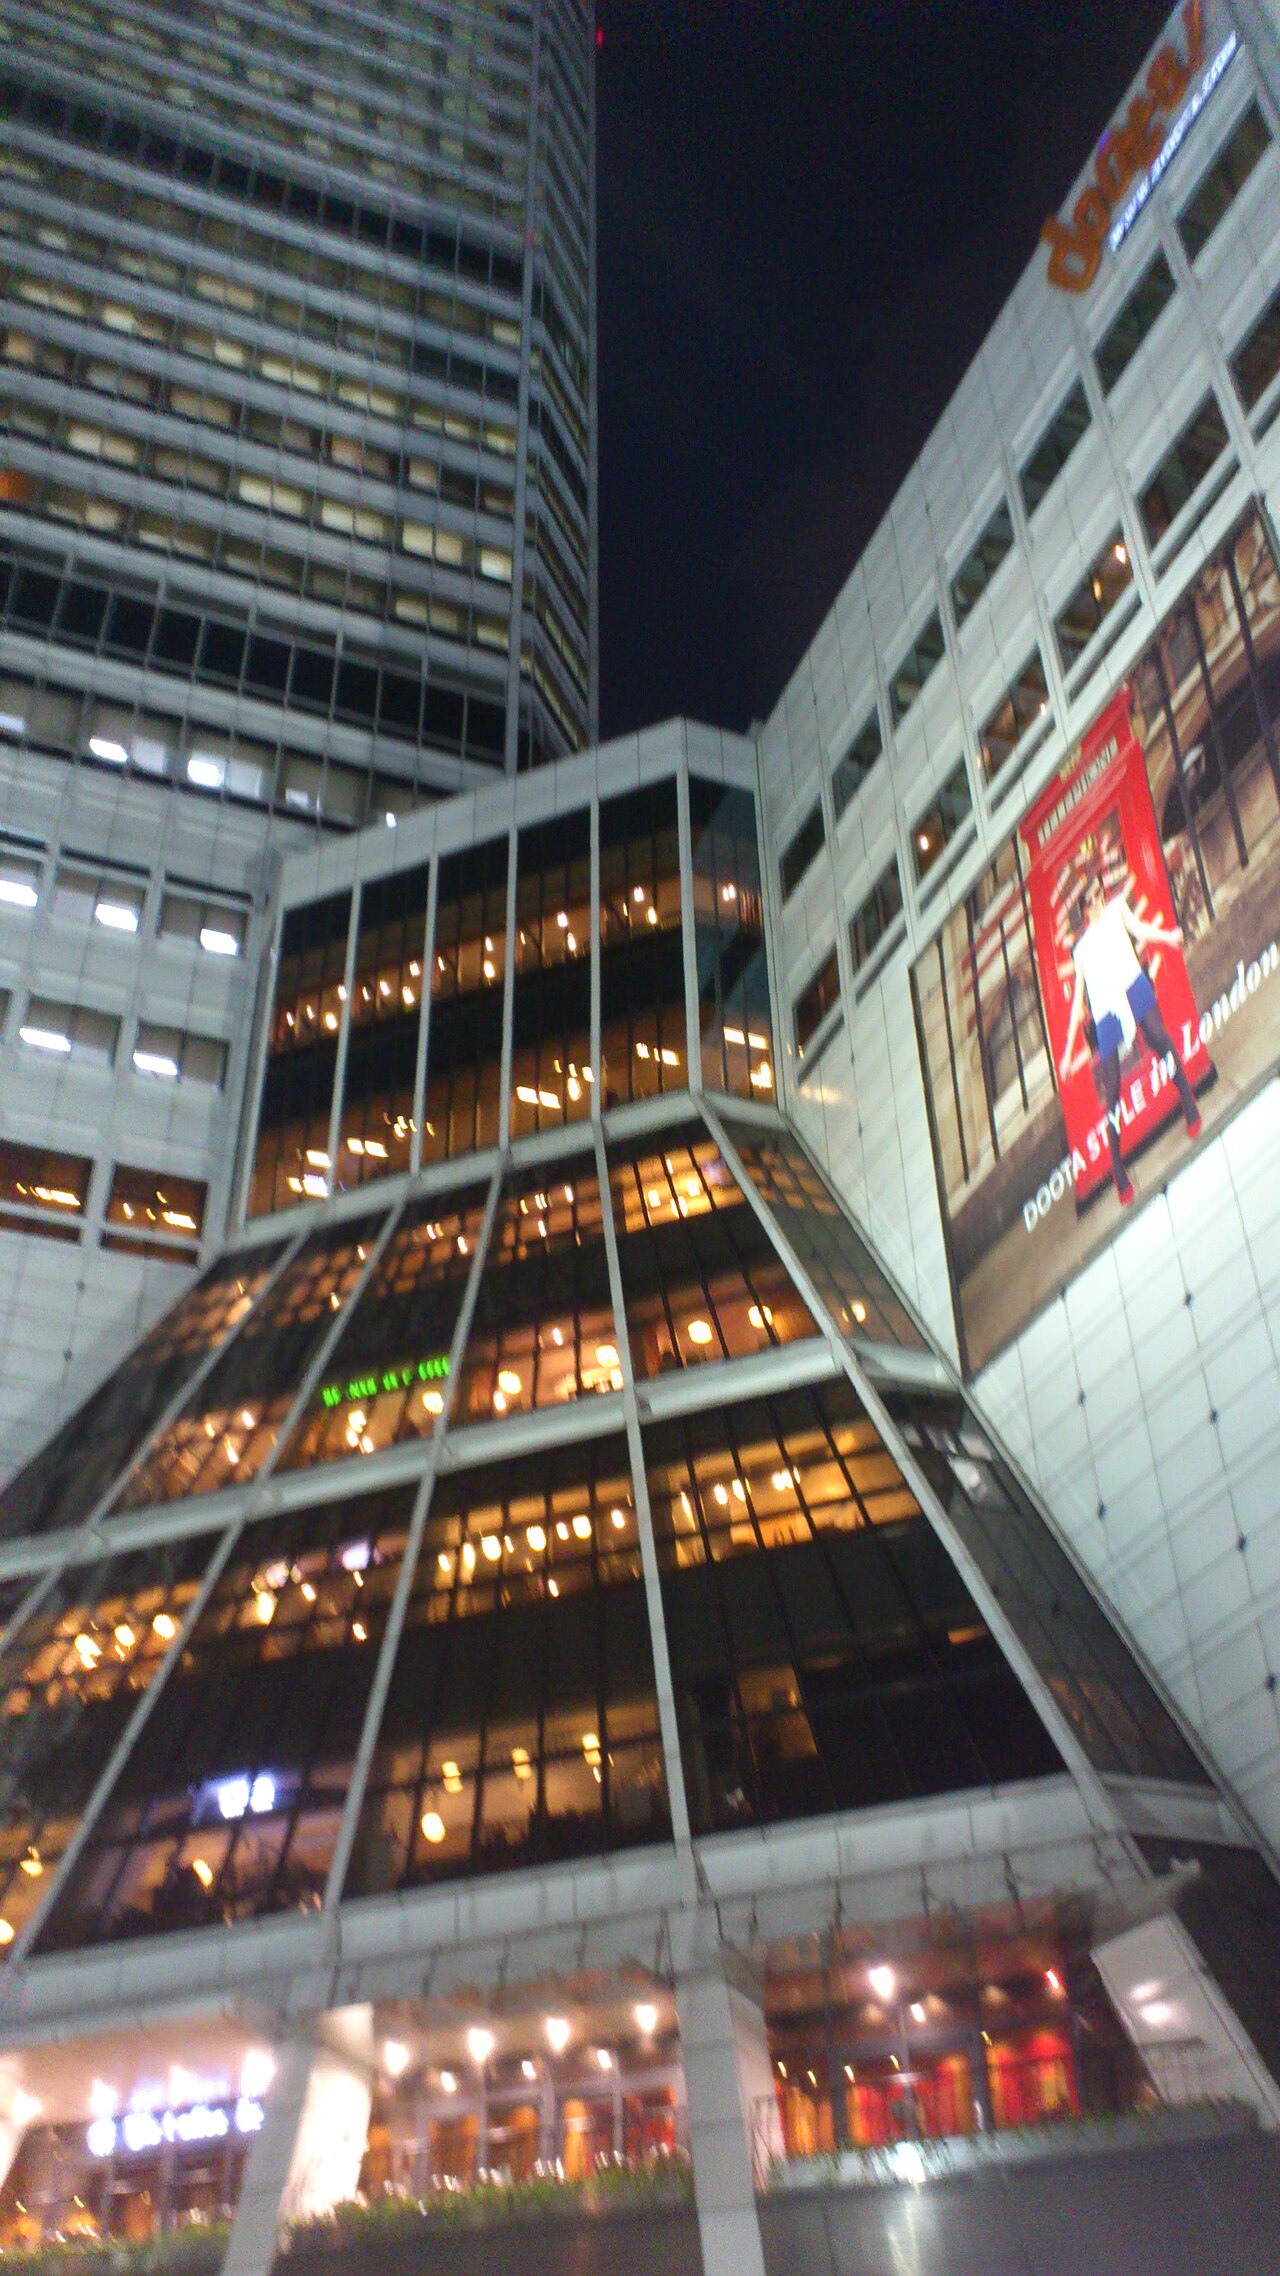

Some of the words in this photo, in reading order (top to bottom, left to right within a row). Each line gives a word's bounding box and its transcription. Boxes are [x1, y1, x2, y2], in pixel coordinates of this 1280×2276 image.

[1022, 1147, 1087, 1232] DOOTA
[1086, 1079, 1146, 1162] STYLE
[1150, 1050, 1175, 1097] in
[1181, 941, 1279, 1062] London
